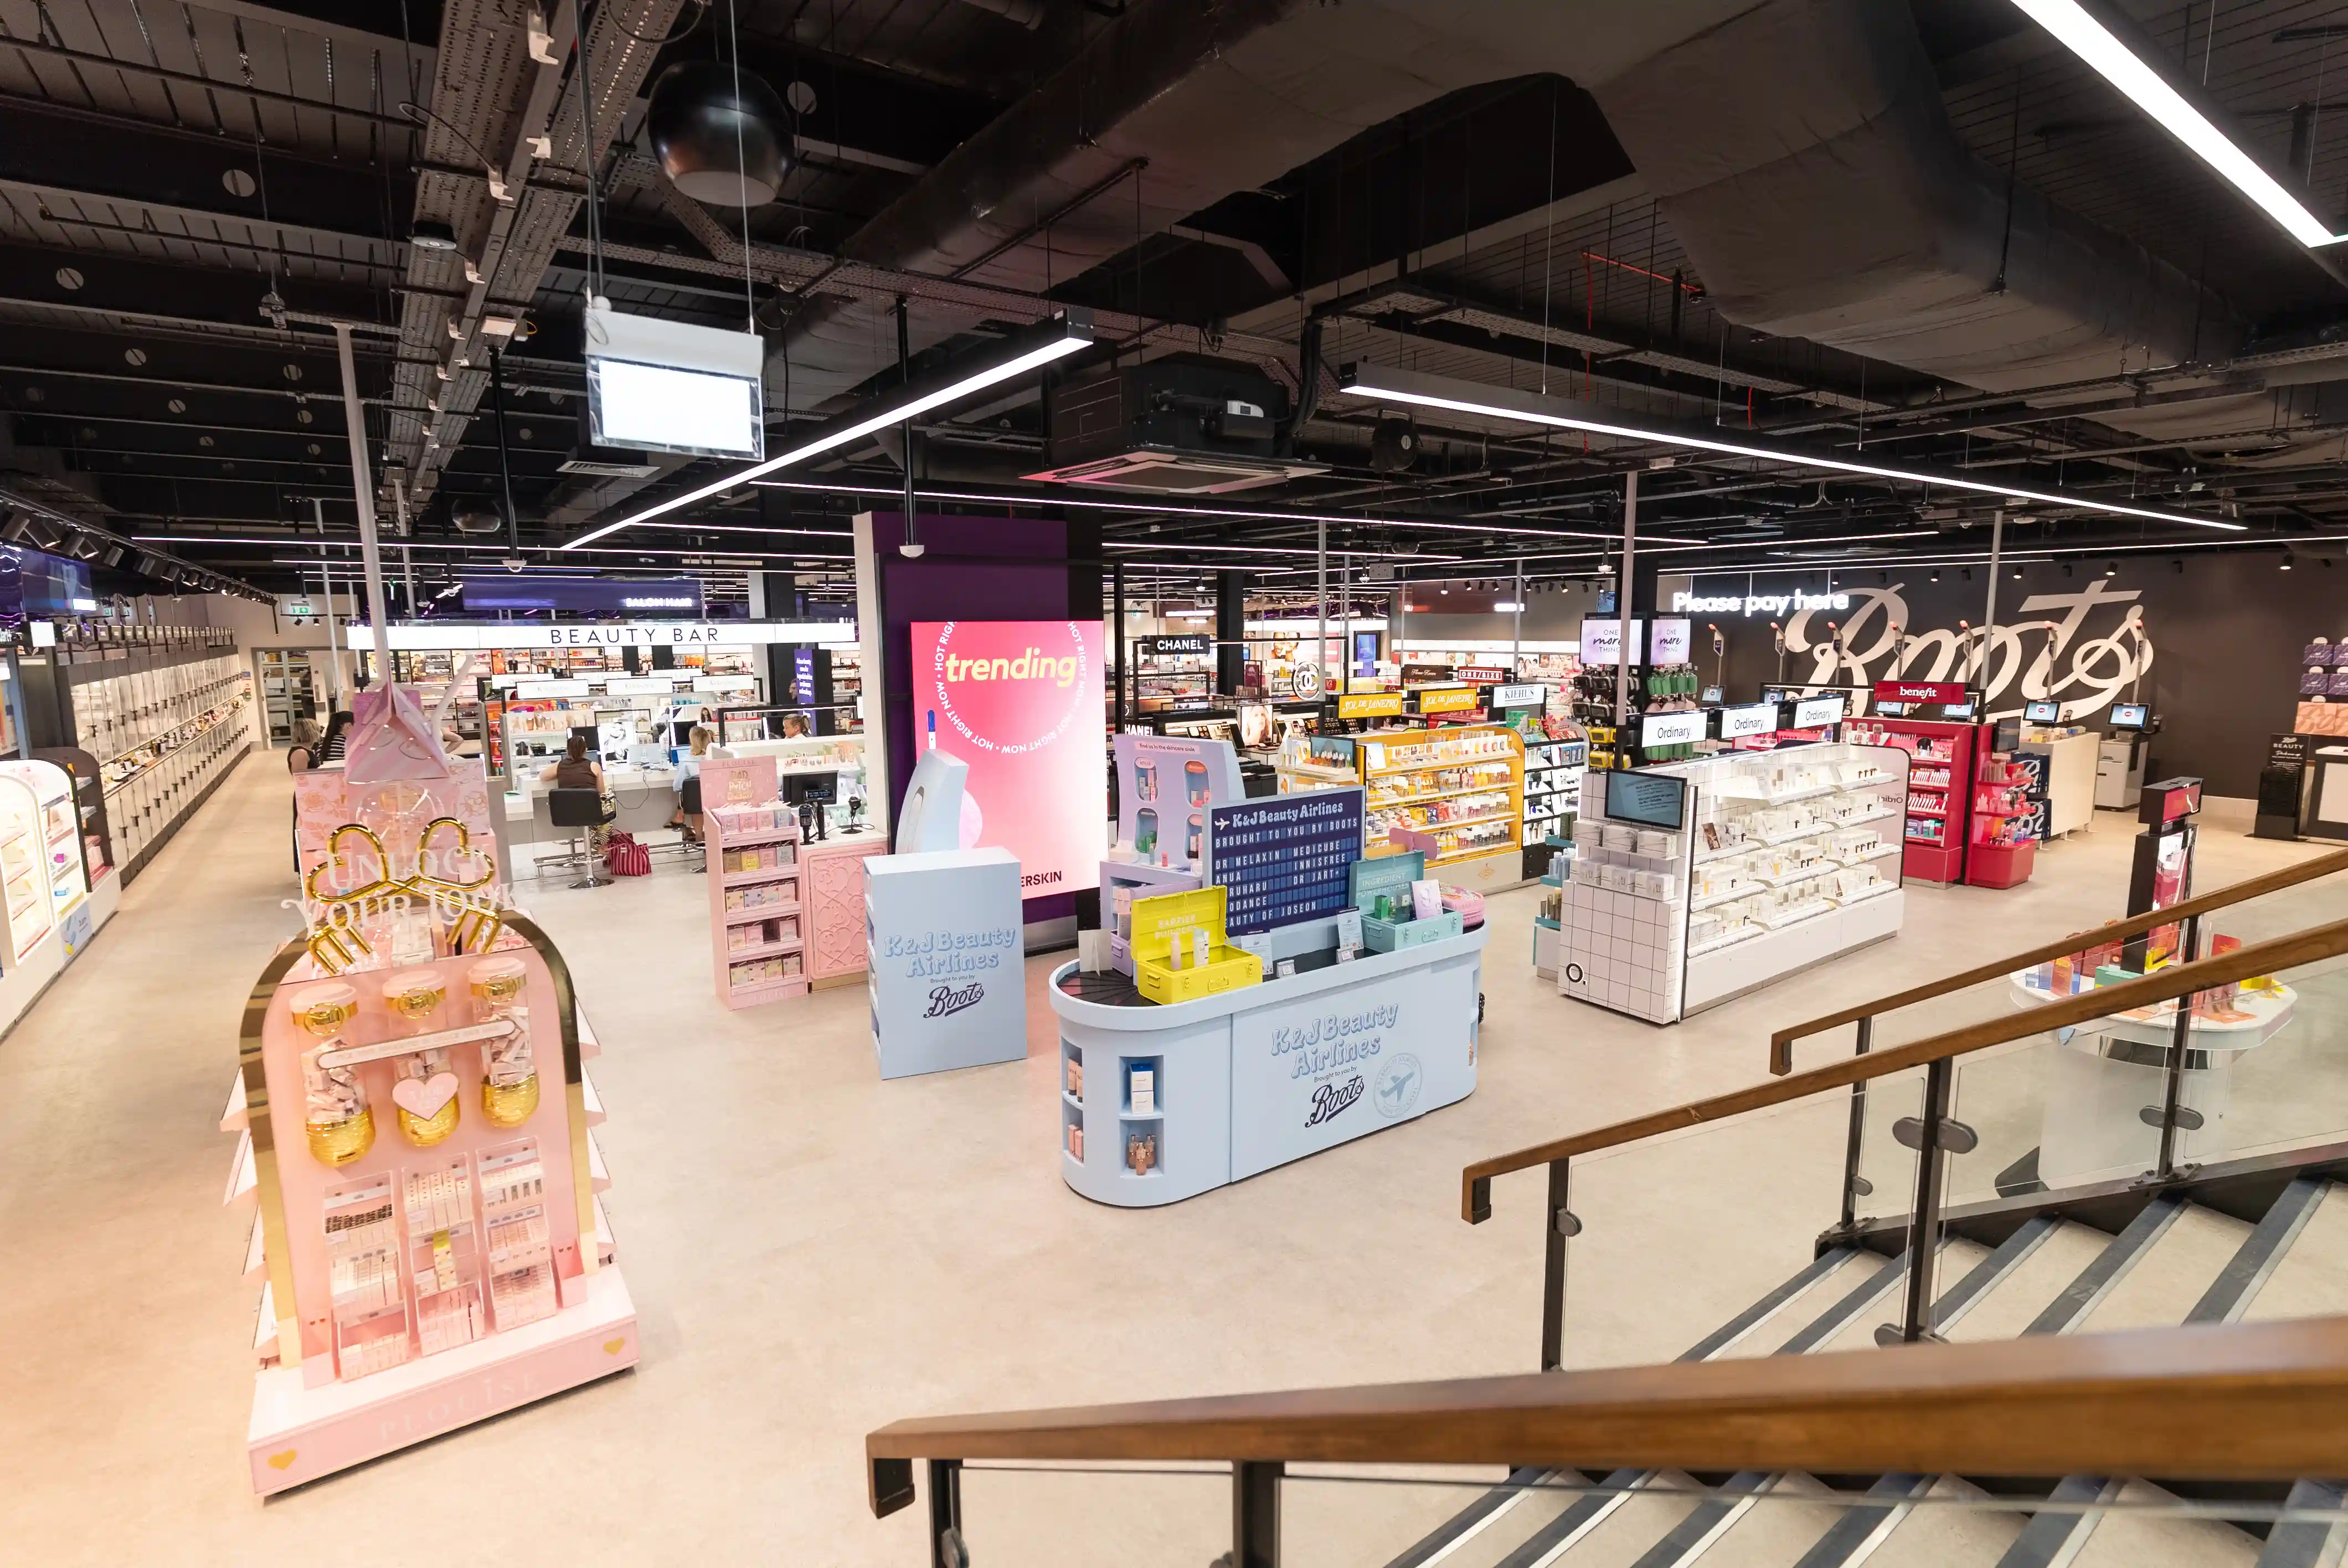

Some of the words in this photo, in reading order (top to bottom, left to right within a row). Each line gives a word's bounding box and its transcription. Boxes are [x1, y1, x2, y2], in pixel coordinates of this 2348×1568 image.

[665, 597, 692, 607] HAIR
[1672, 591, 1741, 613] Please
[1745, 595, 1791, 617] pay
[1794, 588, 1849, 610] here
[550, 628, 655, 643] BEAUTY
[673, 628, 718, 642] BAR
[939, 621, 957, 645] RIGH
[1157, 639, 1204, 651] CHANEL
[935, 646, 945, 671] HOT
[1068, 621, 1082, 643] HOT
[1077, 645, 1087, 678] RIGHT
[1785, 580, 2154, 724] Boots
[945, 647, 1077, 687] trending
[935, 682, 951, 710] NOW
[1423, 696, 1437, 707] SOL
[1444, 693, 1474, 706] JANEIRO
[1505, 688, 1535, 700] KIEHL'S
[1900, 687, 1937, 699] benefit
[1343, 701, 1358, 713] SOL
[1366, 699, 1399, 711] JANEIRO
[946, 705, 973, 739] RIGHT
[1125, 724, 1153, 736] HANEL
[971, 735, 994, 750] HOT
[1001, 744, 1027, 754] NOW
[1029, 731, 1057, 751] RIGHT
[1233, 811, 1257, 828] K&J
[1259, 808, 1299, 824] Beauty
[1300, 802, 1344, 818] Airlines
[1216, 833, 1261, 849] BROUGHT
[1269, 828, 1279, 839] TO
[1288, 826, 1305, 837] YOU
[1312, 823, 1322, 833] BY
[1330, 818, 1357, 831] BOOTS
[315, 844, 491, 890] UNLOCK
[1216, 859, 1227, 870] DR
[1236, 850, 1280, 866] MELAXIN
[1294, 840, 1340, 857] MEDICUBE
[1021, 870, 1062, 887] ERSKIN
[1216, 872, 1241, 885] ANUA
[1294, 854, 1346, 871] INNISFREE
[1362, 873, 1406, 888] INGREDIENT
[1230, 881, 1267, 897] RUHARU
[1294, 875, 1304, 886] DR
[1312, 869, 1339, 882] JART+
[281, 895, 412, 941] YOUR
[419, 880, 520, 926] LOOK
[1226, 913, 1254, 926] AUTY
[1263, 910, 1273, 921] OF
[1280, 901, 1316, 916] JOSEON
[1230, 896, 1267, 912] ODANCE
[1158, 915, 1196, 929] BARRIER
[884, 931, 934, 957] K&J
[936, 927, 1016, 951] Beauty
[906, 952, 999, 978] Airlines
[923, 982, 984, 1018] Boots
[1271, 1018, 1321, 1056] K&J
[1323, 1003, 1399, 1041] Beauty
[1291, 1035, 1381, 1079] Airlines
[1314, 1073, 1334, 1083] Brought
[1304, 1074, 1364, 1128] Boots
